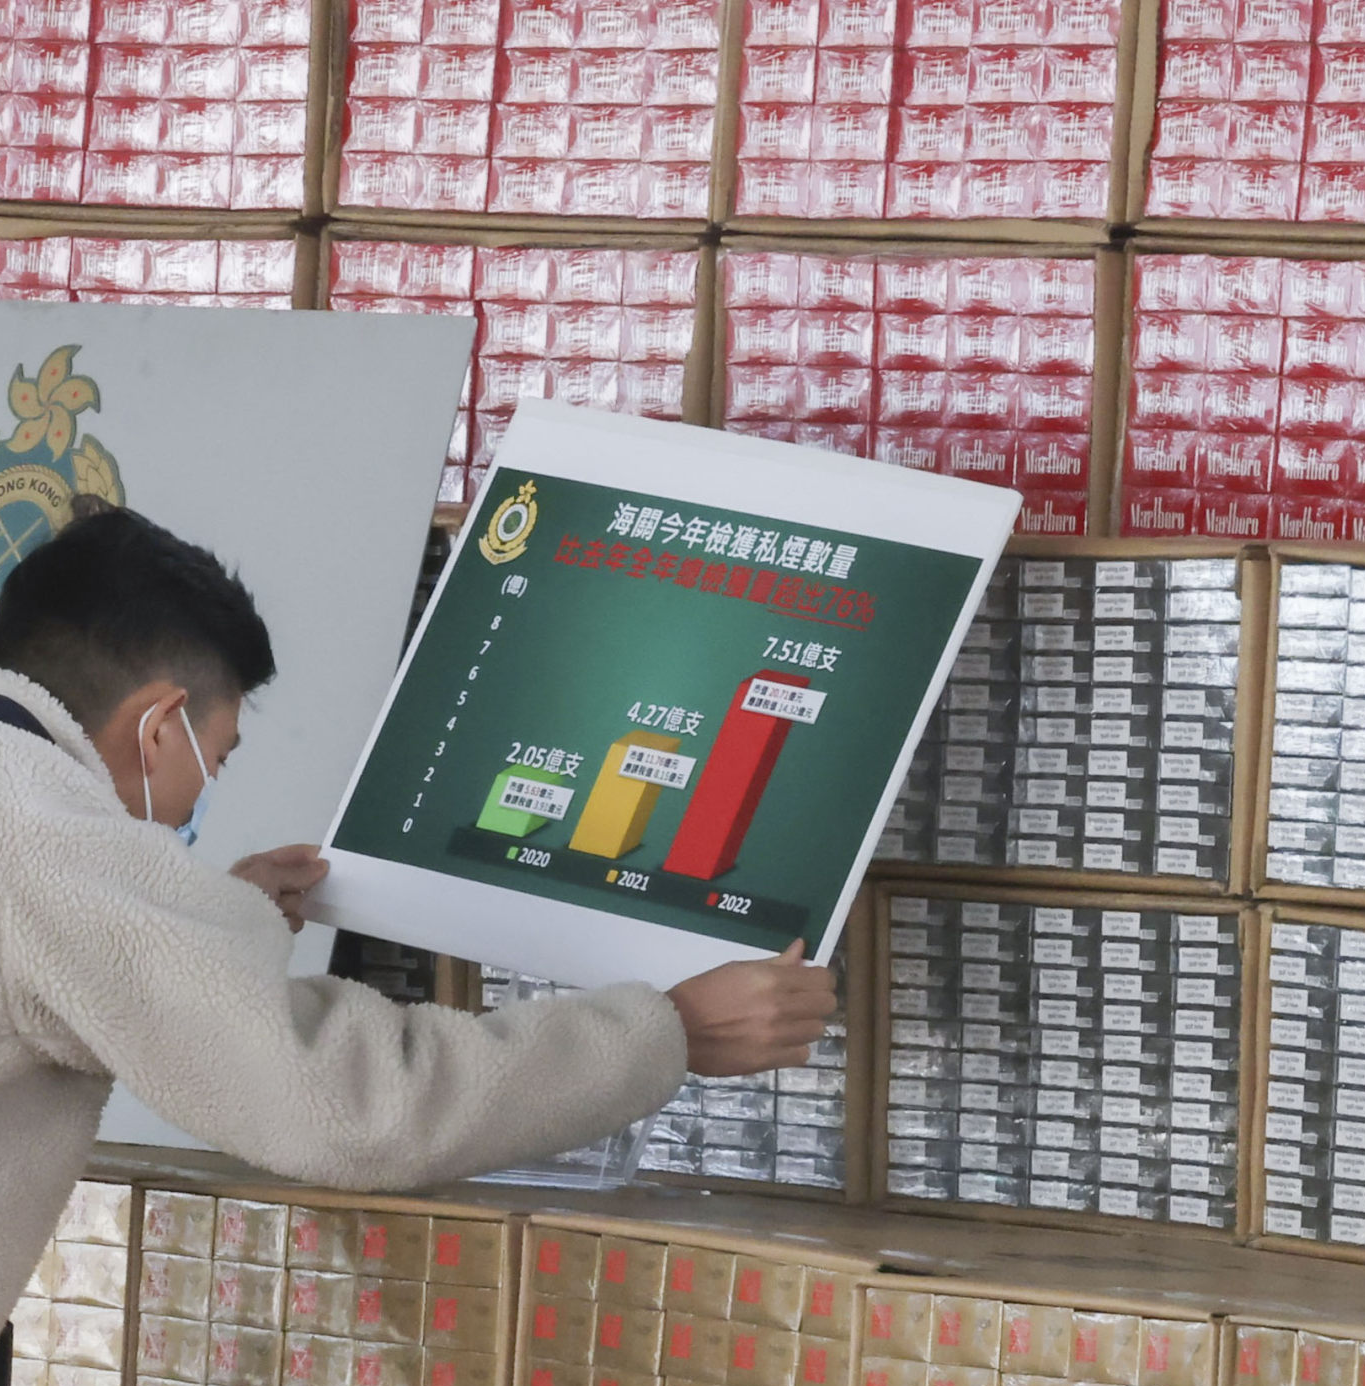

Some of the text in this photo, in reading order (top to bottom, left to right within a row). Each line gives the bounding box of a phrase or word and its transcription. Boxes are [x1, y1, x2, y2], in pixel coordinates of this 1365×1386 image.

[888, 439, 936, 470] Marlboro
[951, 441, 1005, 471] Marlboro
[1025, 443, 1080, 475] Marlboro
[1134, 441, 1186, 472] Marlboro
[1207, 443, 1261, 476] Marlboro
[1284, 449, 1339, 481] Marlboro
[28, 479, 62, 508] KONG
[1022, 501, 1075, 531] Marlboro
[1131, 499, 1184, 529] Marlboro
[1205, 503, 1258, 534] Marlboro
[1279, 508, 1335, 539] Marlboro
[606, 501, 859, 581] 海關今年檢獲私煙數量
[501, 574, 529, 598] (億)
[554, 533, 876, 625] 比去年全年總檢獲量超出76%
[490, 615, 501, 631] 8
[479, 639, 491, 656] 7
[762, 636, 842, 672] 7.51億支
[469, 665, 478, 681] 6
[458, 690, 466, 706] 5
[446, 716, 456, 732] 4
[627, 701, 705, 738] 4.27億支
[435, 742, 444, 757] 3
[506, 741, 584, 778] 2.05億支
[424, 766, 432, 783] 2
[414, 793, 422, 807] 1
[402, 818, 412, 834] 0
[517, 847, 550, 868] 2020
[618, 869, 650, 892] 2021
[718, 892, 751, 914] 2022
